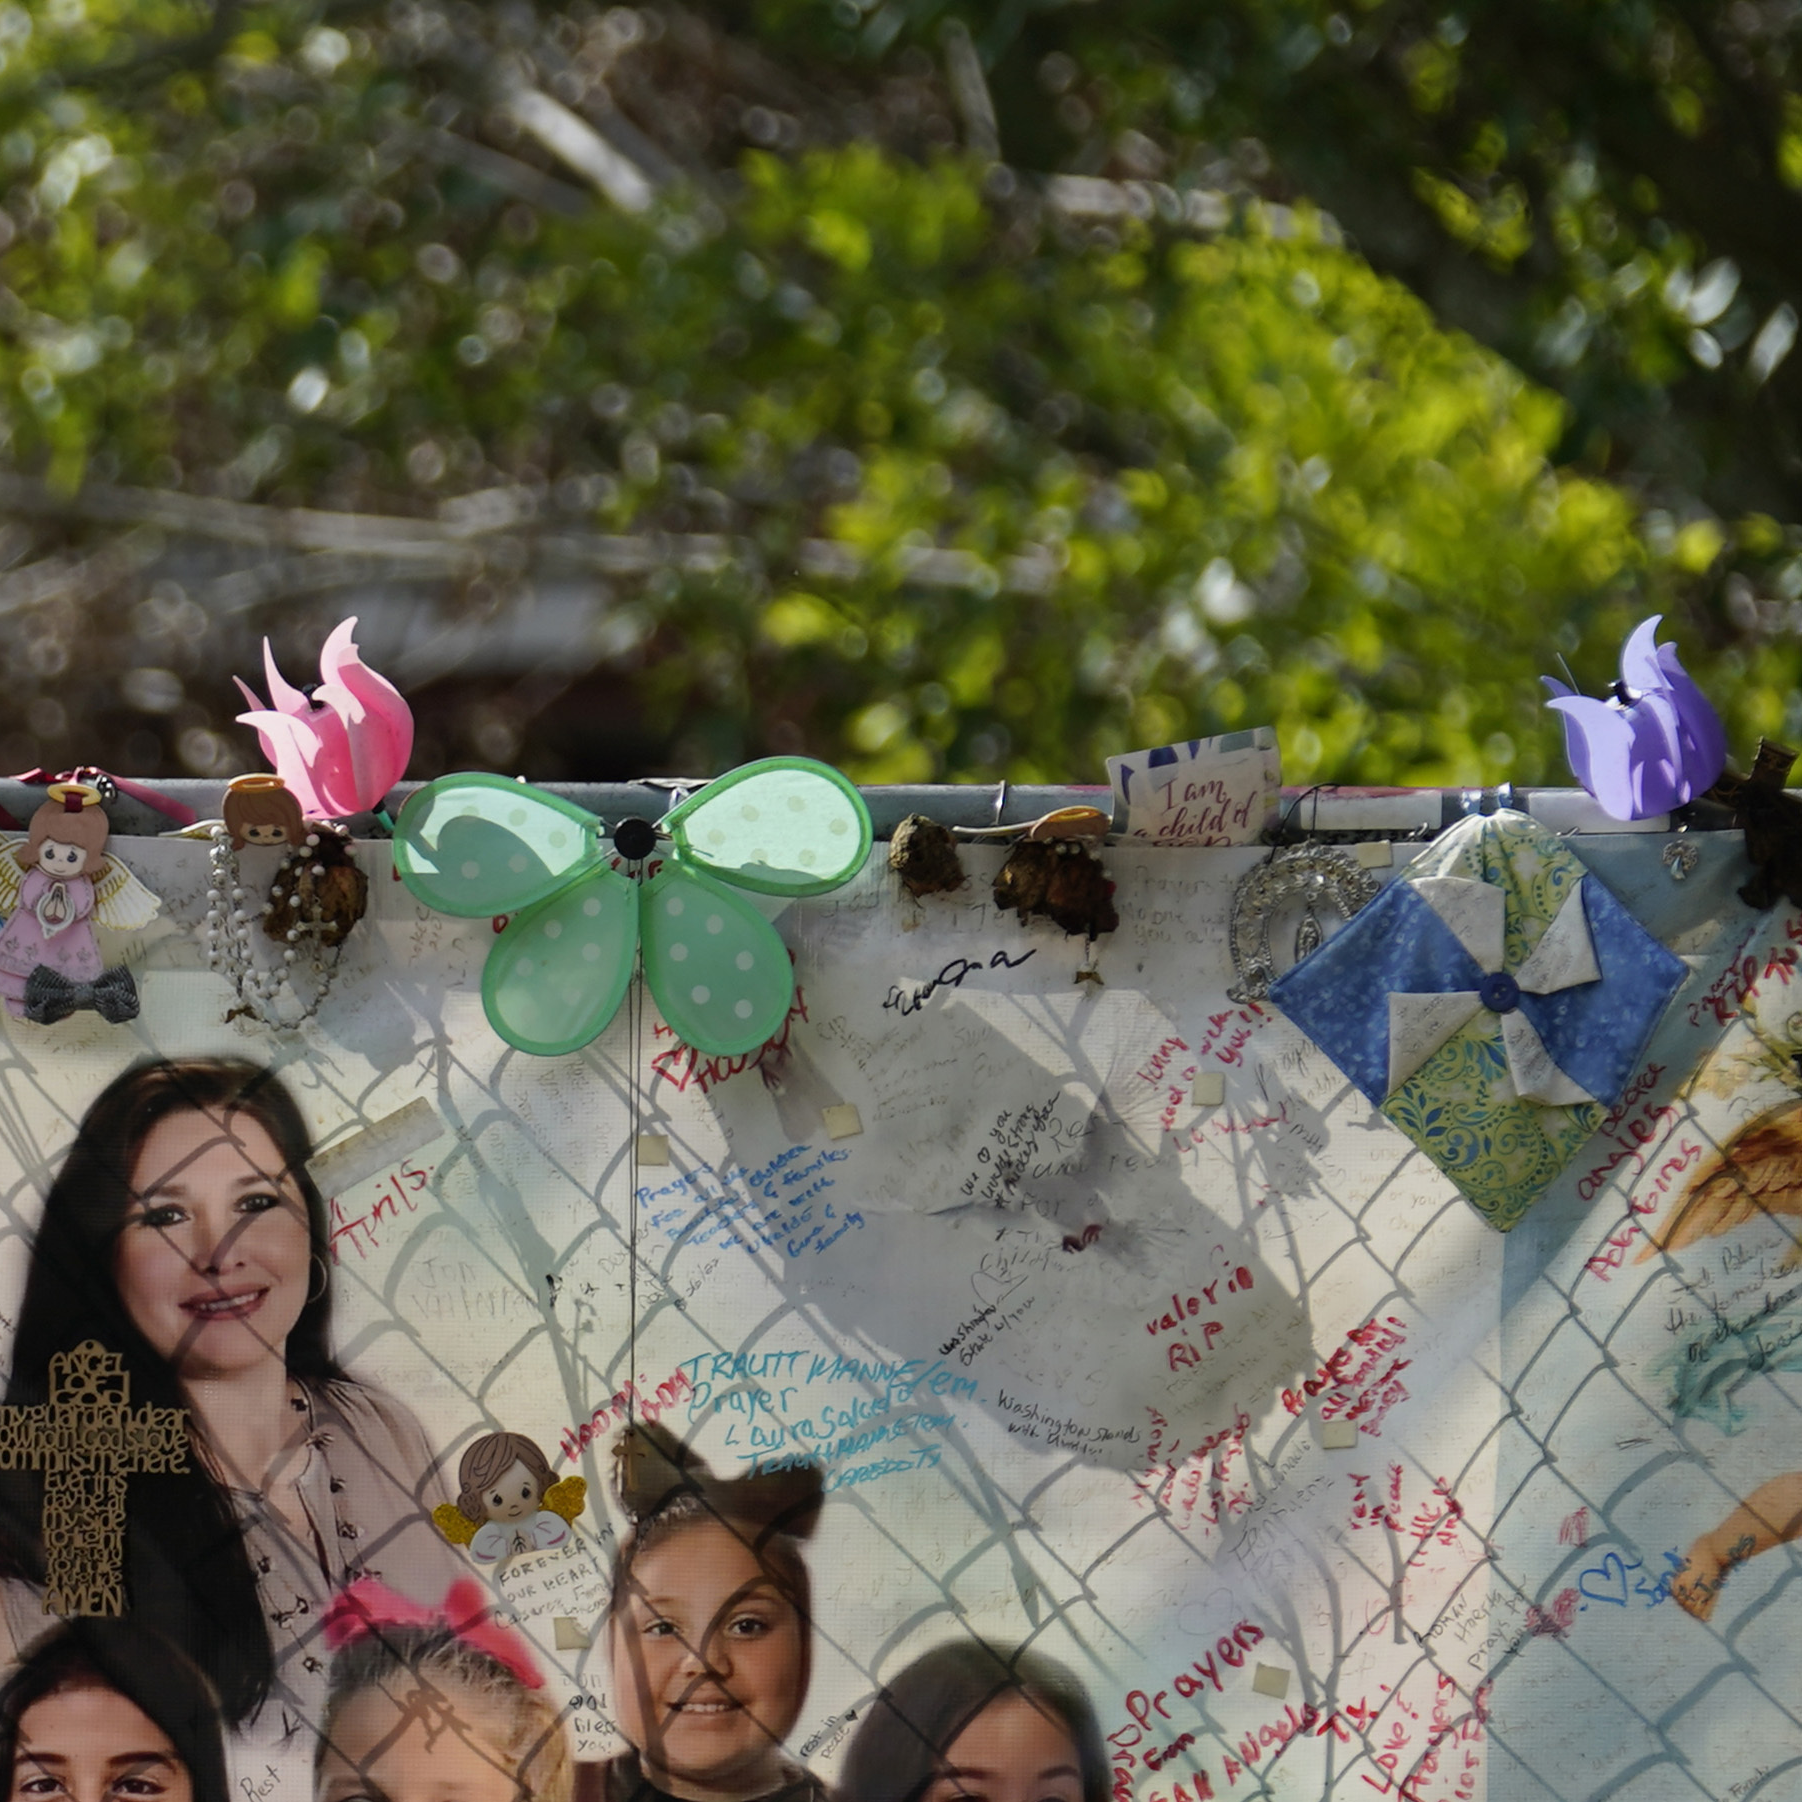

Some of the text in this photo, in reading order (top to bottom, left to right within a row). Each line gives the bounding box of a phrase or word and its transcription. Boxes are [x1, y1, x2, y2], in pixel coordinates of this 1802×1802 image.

[1161, 777, 1178, 816] I
[1159, 797, 1231, 838] child
[49, 1352, 123, 1374] ANGEL
[135, 1402, 191, 1427] dear
[144, 1427, 189, 1451] love
[42, 1586, 123, 1617] AMEN
[1125, 1618, 1265, 1731] Prayers
